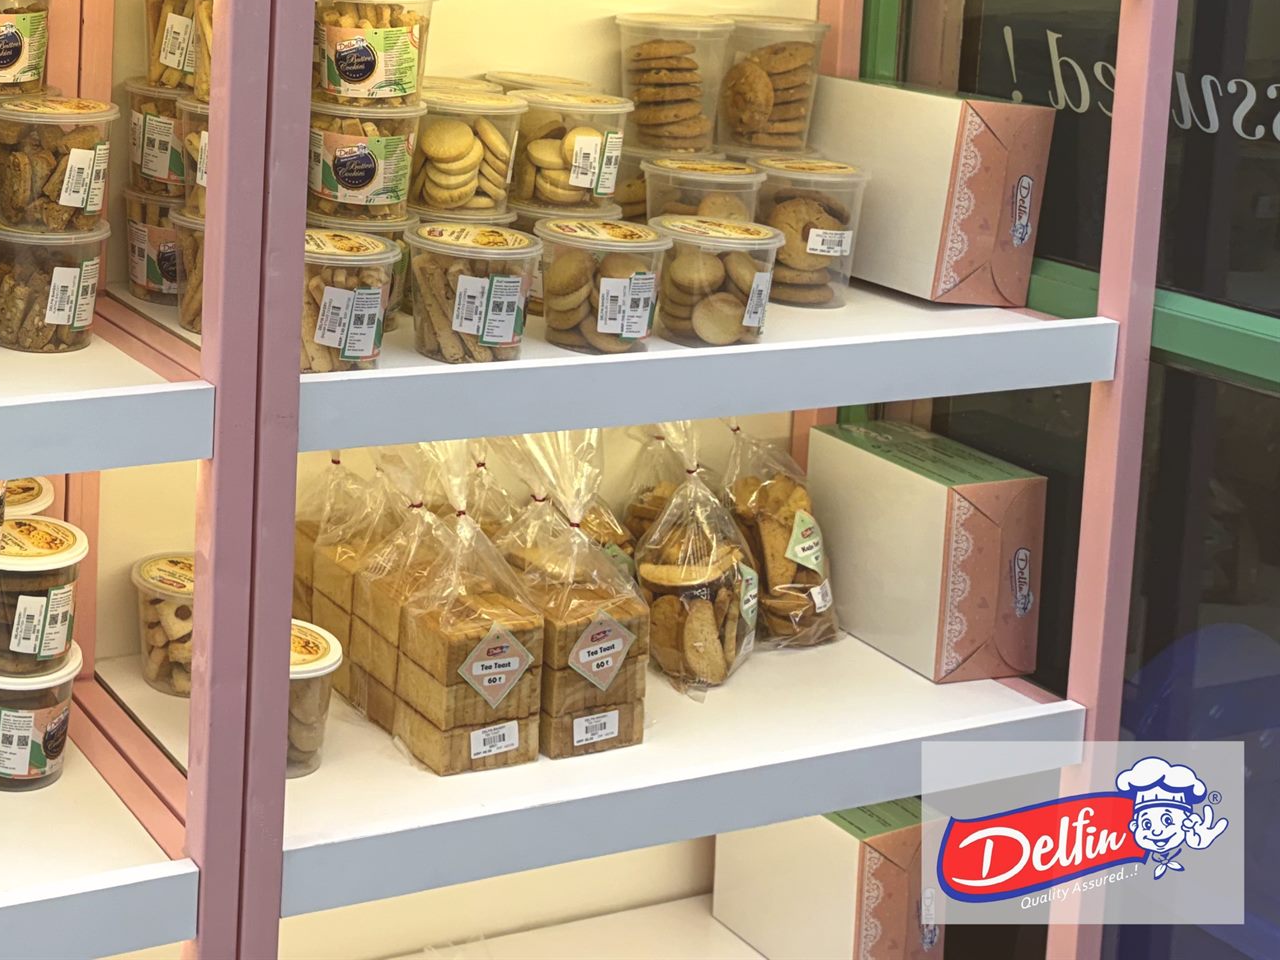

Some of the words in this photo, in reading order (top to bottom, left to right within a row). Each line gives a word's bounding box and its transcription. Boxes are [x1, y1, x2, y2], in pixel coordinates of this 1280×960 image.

[586, 649, 599, 658] Tea
[599, 644, 616, 654] Toast
[481, 663, 494, 671] Tea
[495, 661, 511, 669] Toast
[595, 662, 605, 670] 60
[487, 676, 497, 684] 60
